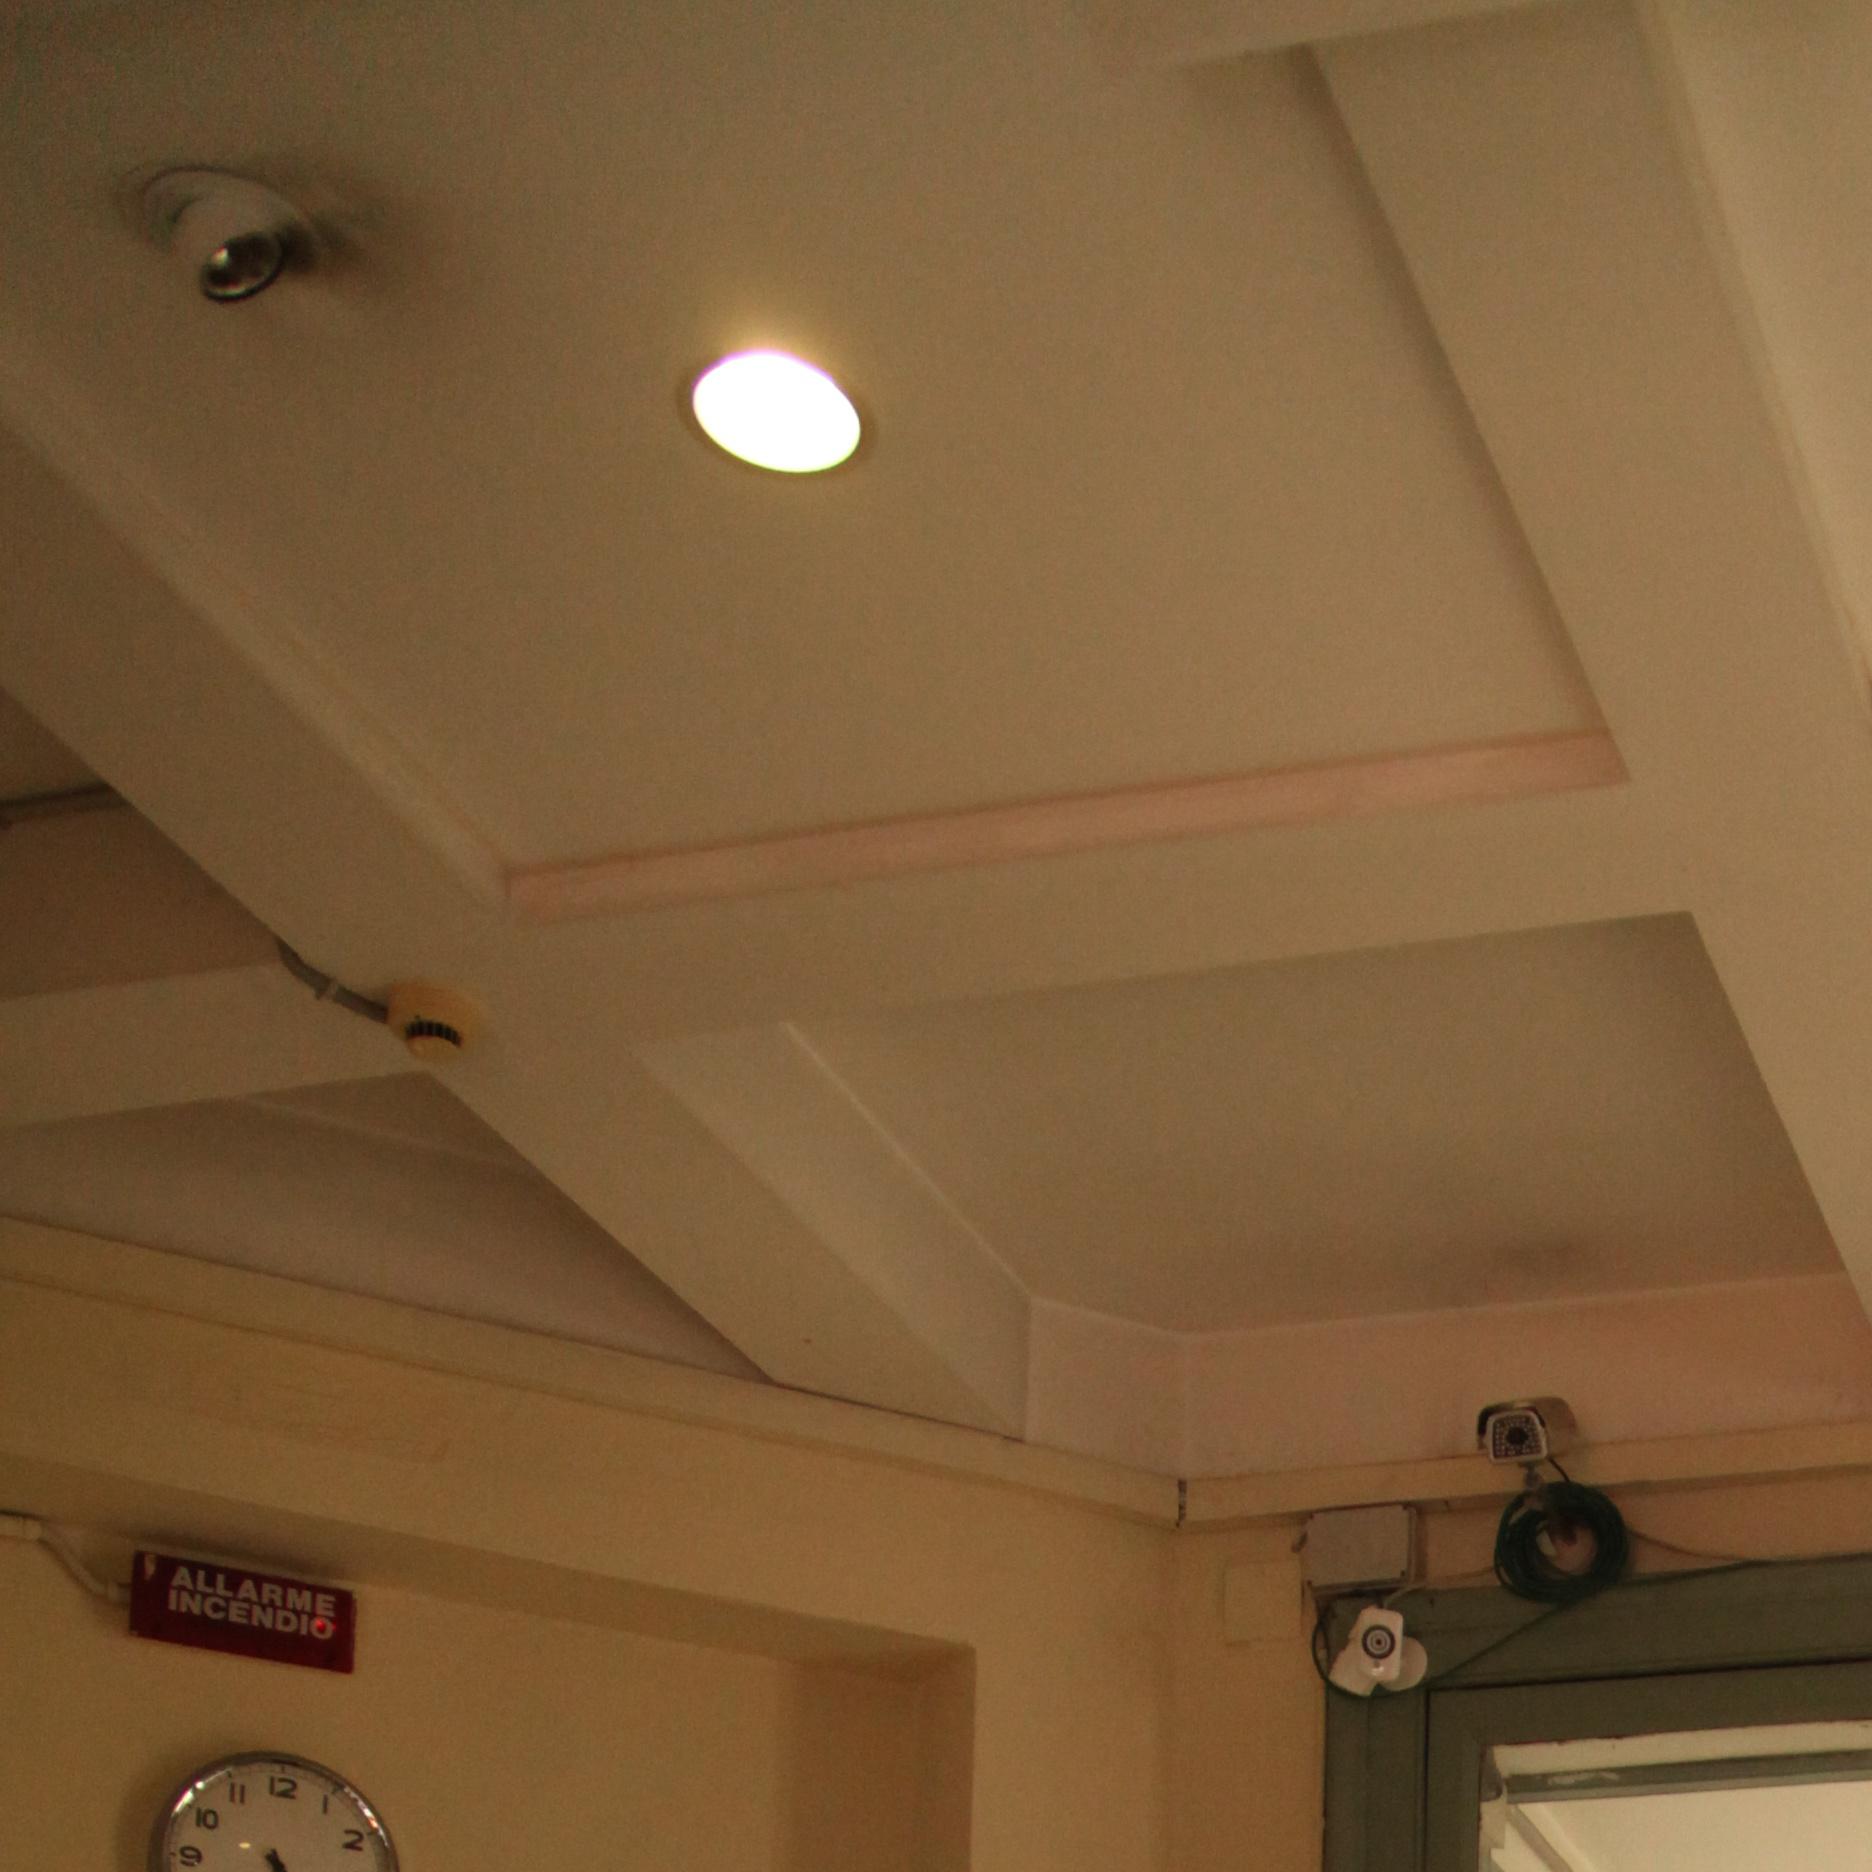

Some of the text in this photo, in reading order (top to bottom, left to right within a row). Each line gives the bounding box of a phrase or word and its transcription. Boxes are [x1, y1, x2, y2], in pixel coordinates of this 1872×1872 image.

[171, 1566, 336, 1617] ALLARME
[168, 1589, 334, 1640] INCENDIO
[229, 1782, 246, 1804] 11
[269, 1776, 297, 1800] 12
[322, 1794, 328, 1814] 1
[195, 1807, 219, 1830] 10
[342, 1829, 364, 1851] 2
[179, 1845, 203, 1867] 9
